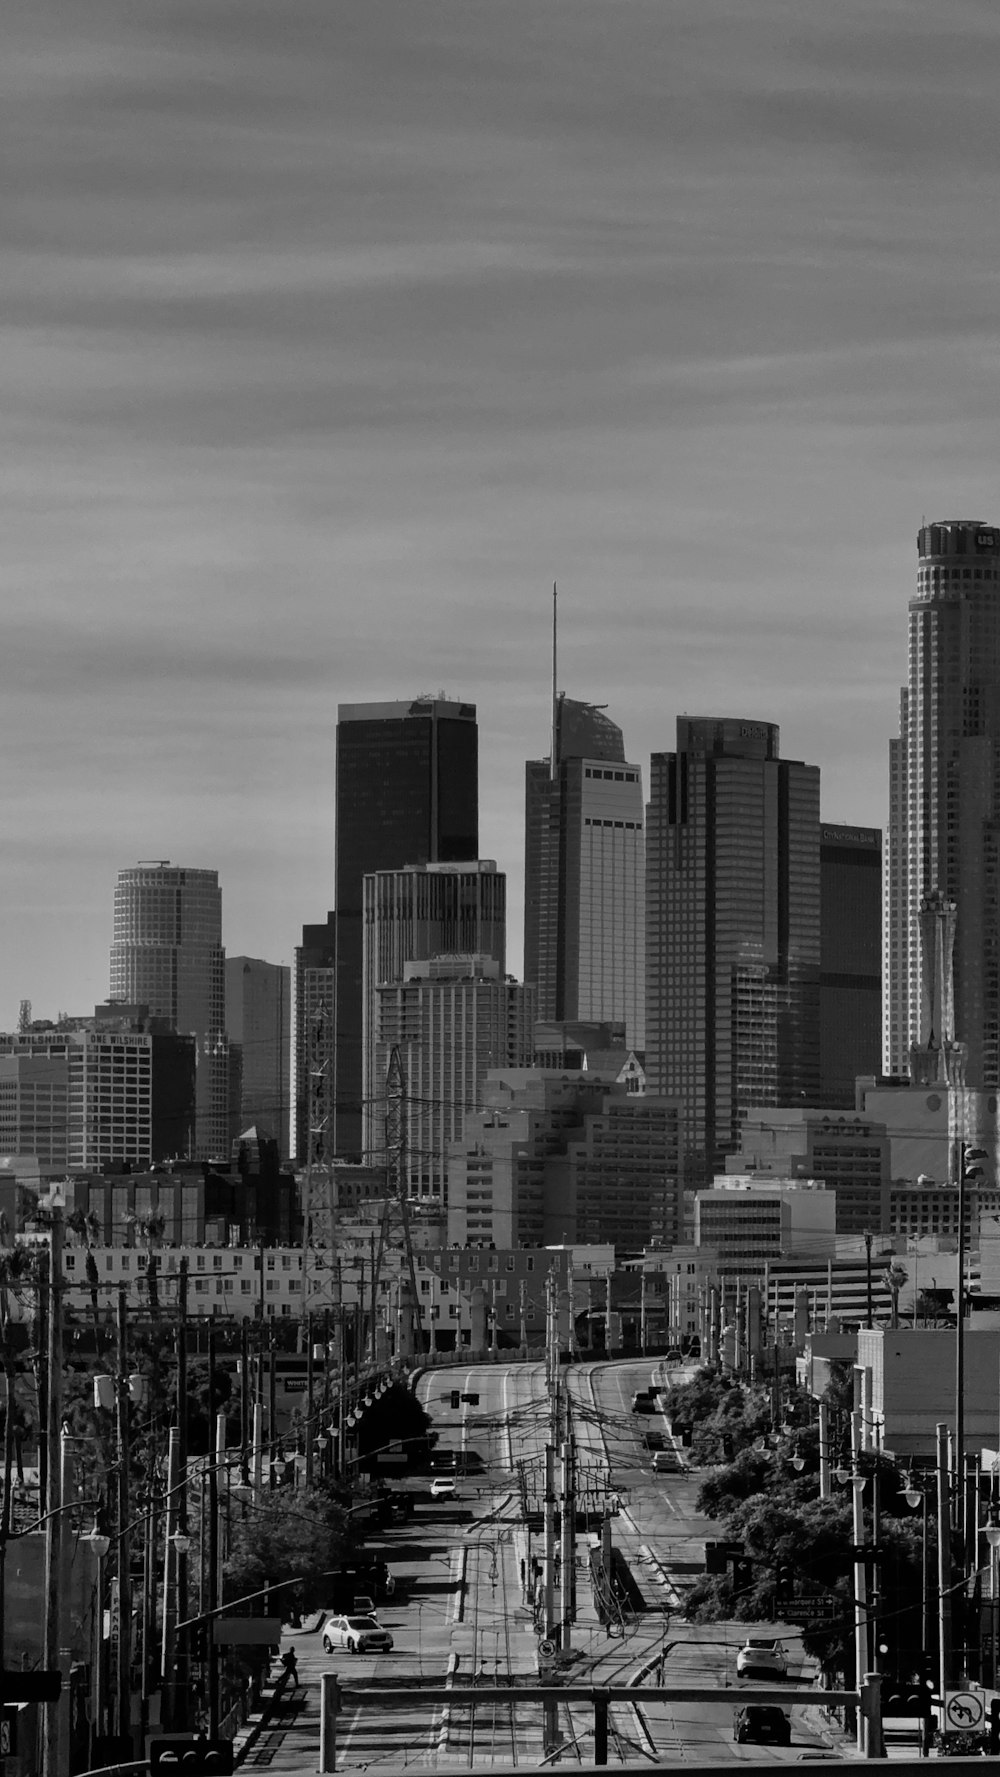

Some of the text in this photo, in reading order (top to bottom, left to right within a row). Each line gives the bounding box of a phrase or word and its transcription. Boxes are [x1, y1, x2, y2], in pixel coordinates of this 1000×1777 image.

[18, 1035, 70, 1045] WILSHIRE
[91, 1035, 148, 1046] ONE WILSHIRE
